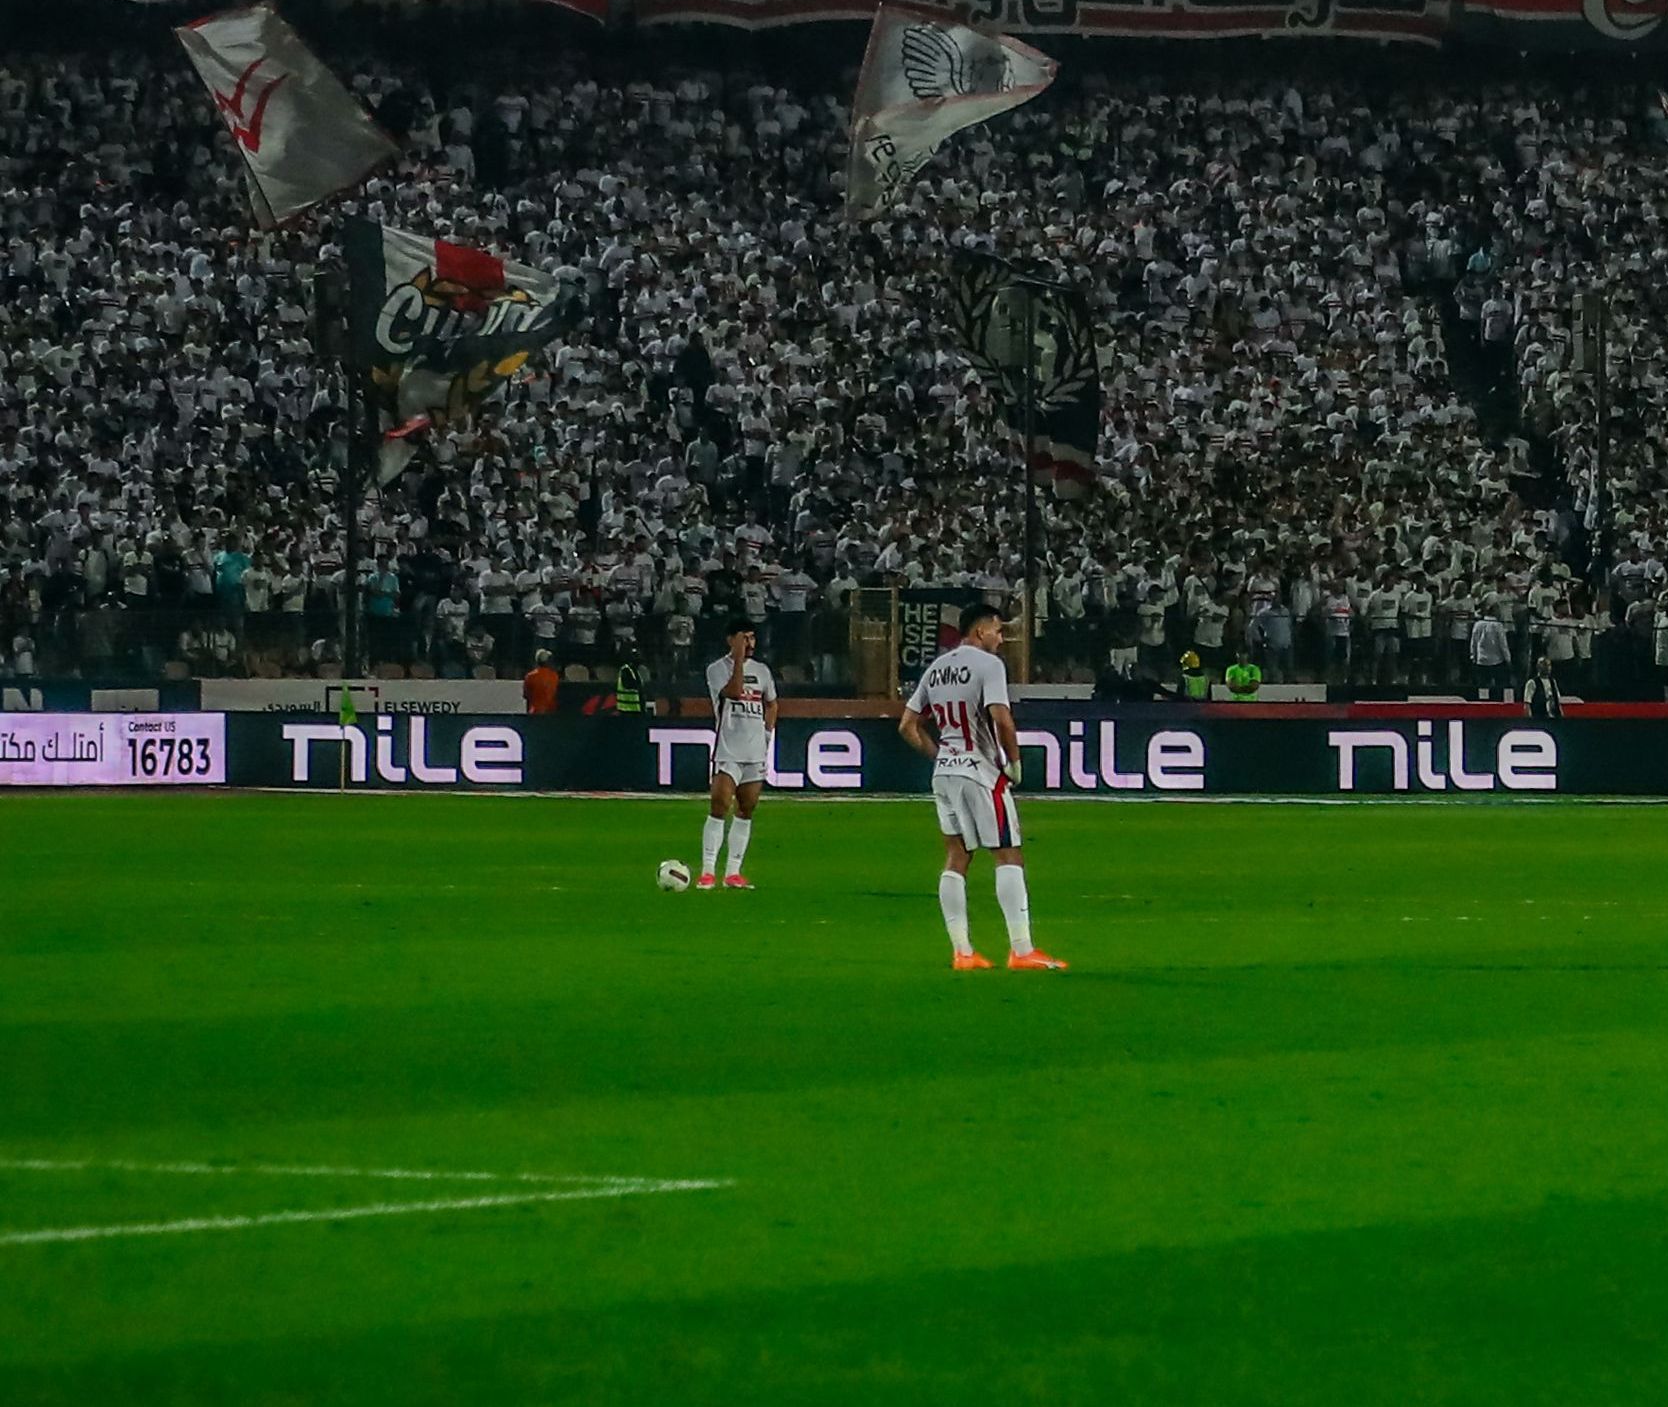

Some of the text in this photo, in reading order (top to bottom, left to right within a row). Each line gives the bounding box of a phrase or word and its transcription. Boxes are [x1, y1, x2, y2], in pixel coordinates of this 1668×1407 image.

[929, 666, 971, 689] ONIRO
[128, 721, 162, 732] Contact
[128, 737, 211, 776] 16783
